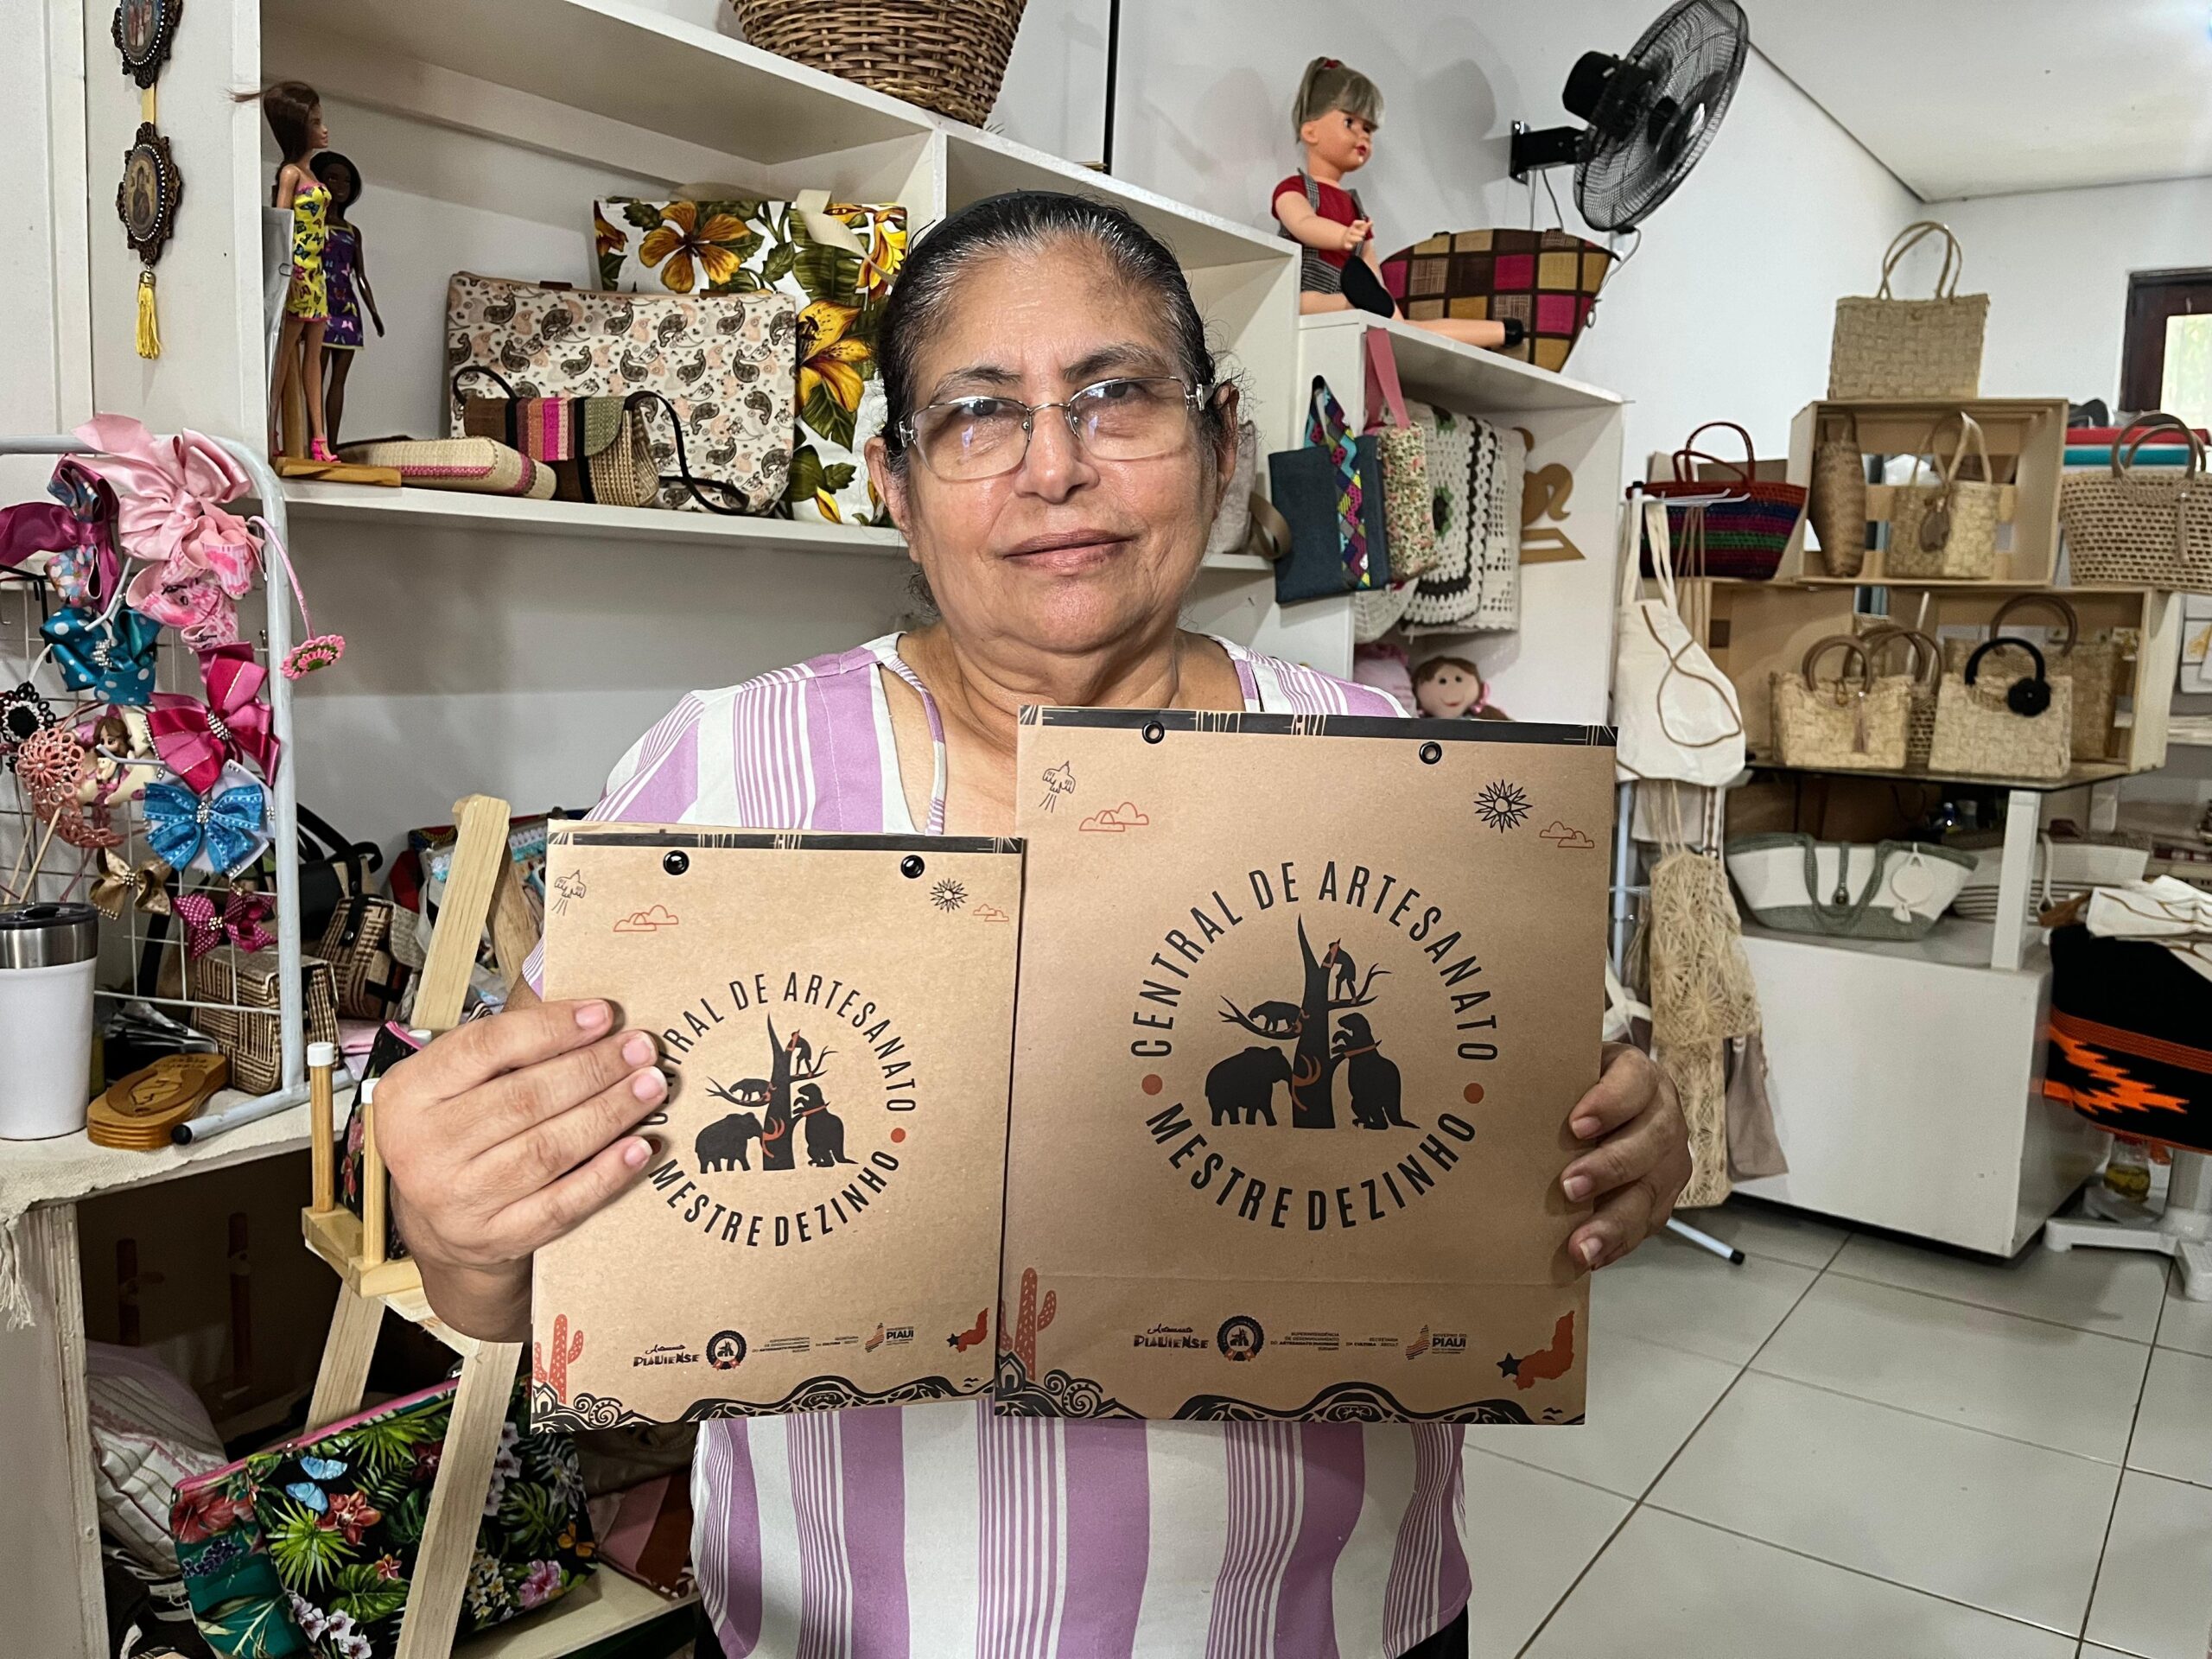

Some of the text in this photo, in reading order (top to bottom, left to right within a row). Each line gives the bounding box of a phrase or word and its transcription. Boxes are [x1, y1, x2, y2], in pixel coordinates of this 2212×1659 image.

[1130, 861, 1498, 1061] CENTRAL DE ARTESANATO
[728, 973, 769, 1011] DE
[783, 971, 917, 1113] ARTESANATO
[648, 1150, 900, 1247] MESTRE DEZINHO
[1145, 1103, 1476, 1231] MESTRE DEZINHO
